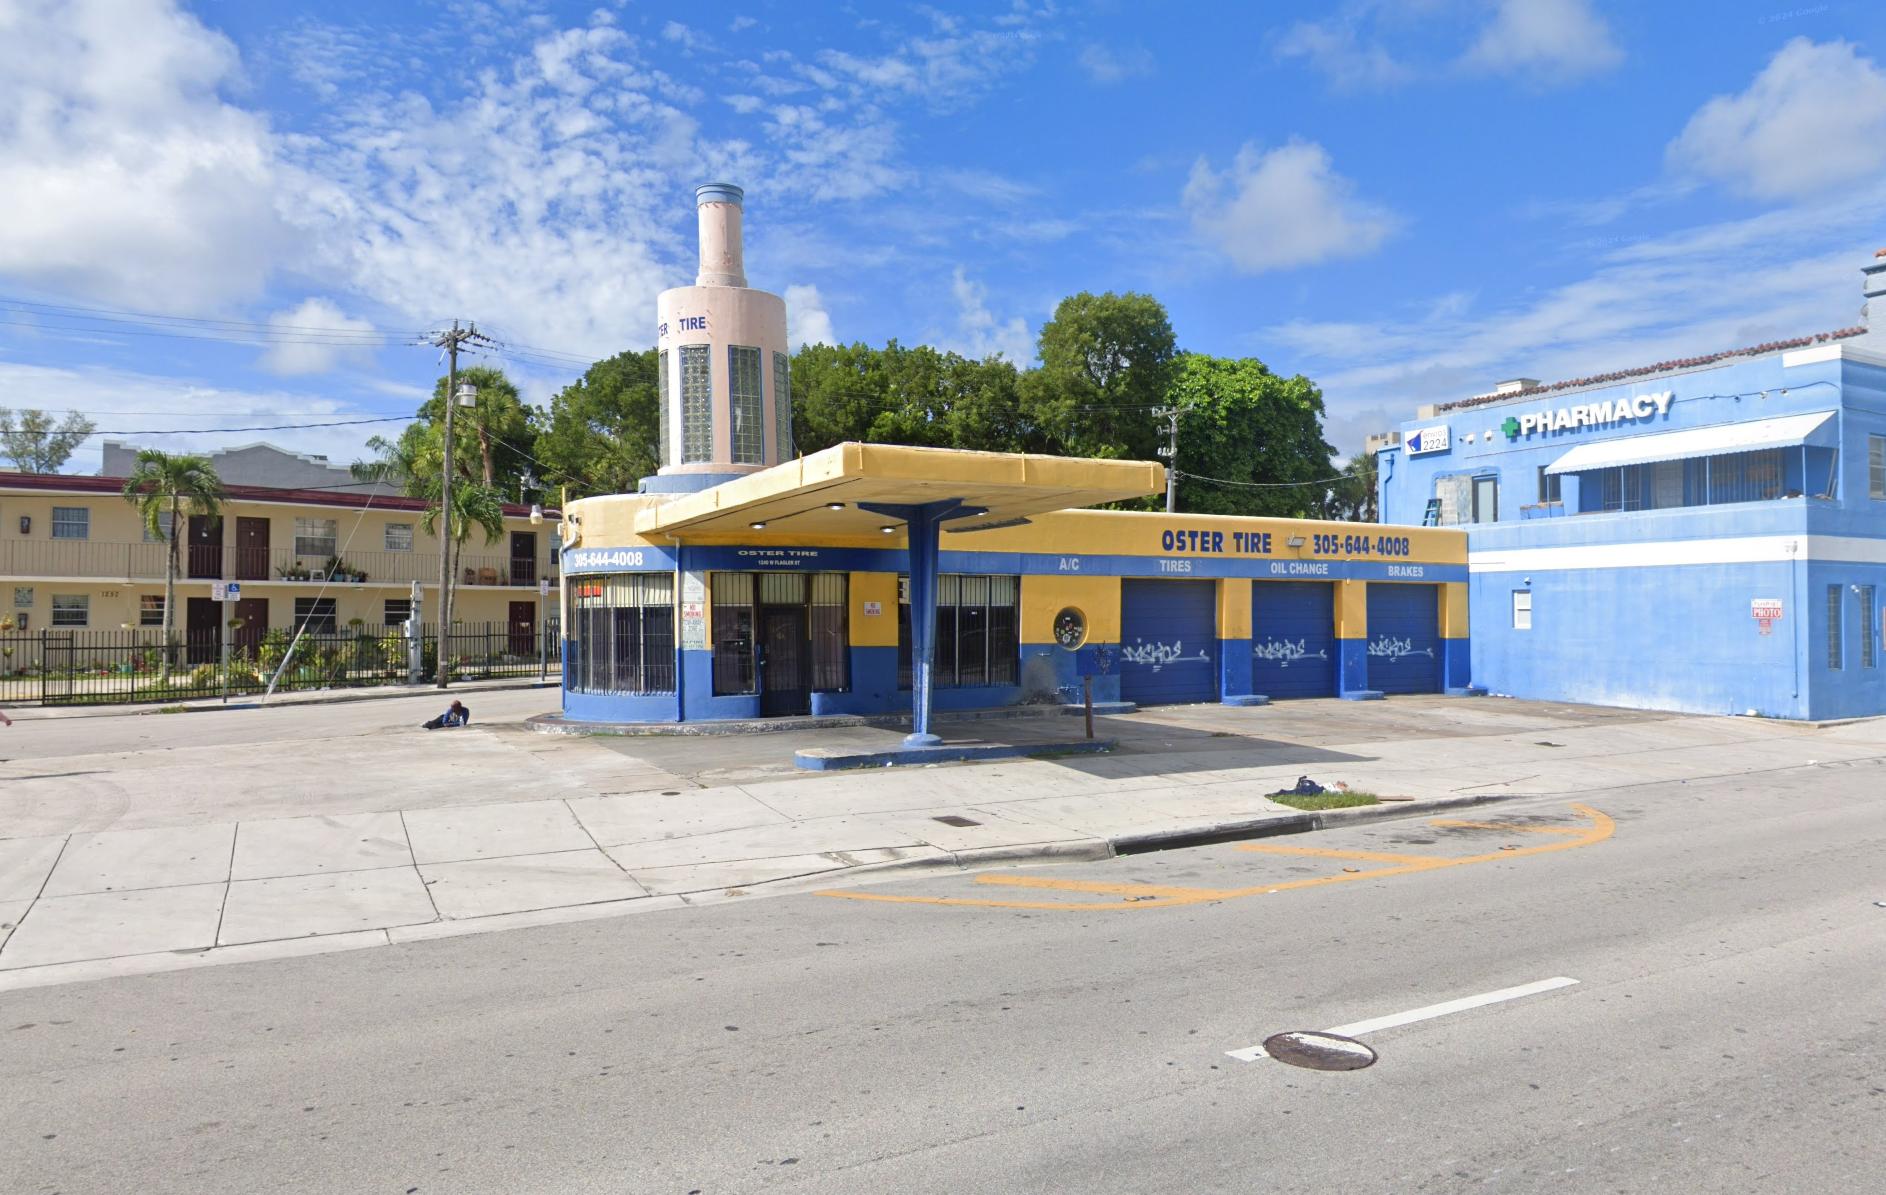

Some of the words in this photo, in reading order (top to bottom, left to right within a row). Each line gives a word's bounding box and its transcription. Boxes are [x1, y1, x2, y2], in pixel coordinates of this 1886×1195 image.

[679, 316, 706, 331] TIRE
[1520, 390, 1672, 435] PHARMACY
[1423, 438, 1447, 451] 2224
[1161, 529, 1223, 553] OSTER
[1233, 531, 1272, 554] TIRE
[574, 551, 643, 567] 305-644-4008
[1059, 558, 1079, 571] A/C
[1160, 560, 1191, 573] TIRES
[1270, 562, 1287, 574] OIL
[1289, 563, 1328, 575] CHANGE
[1388, 565, 1423, 578] BRAKES
[1753, 608, 1780, 617] PHOTO
